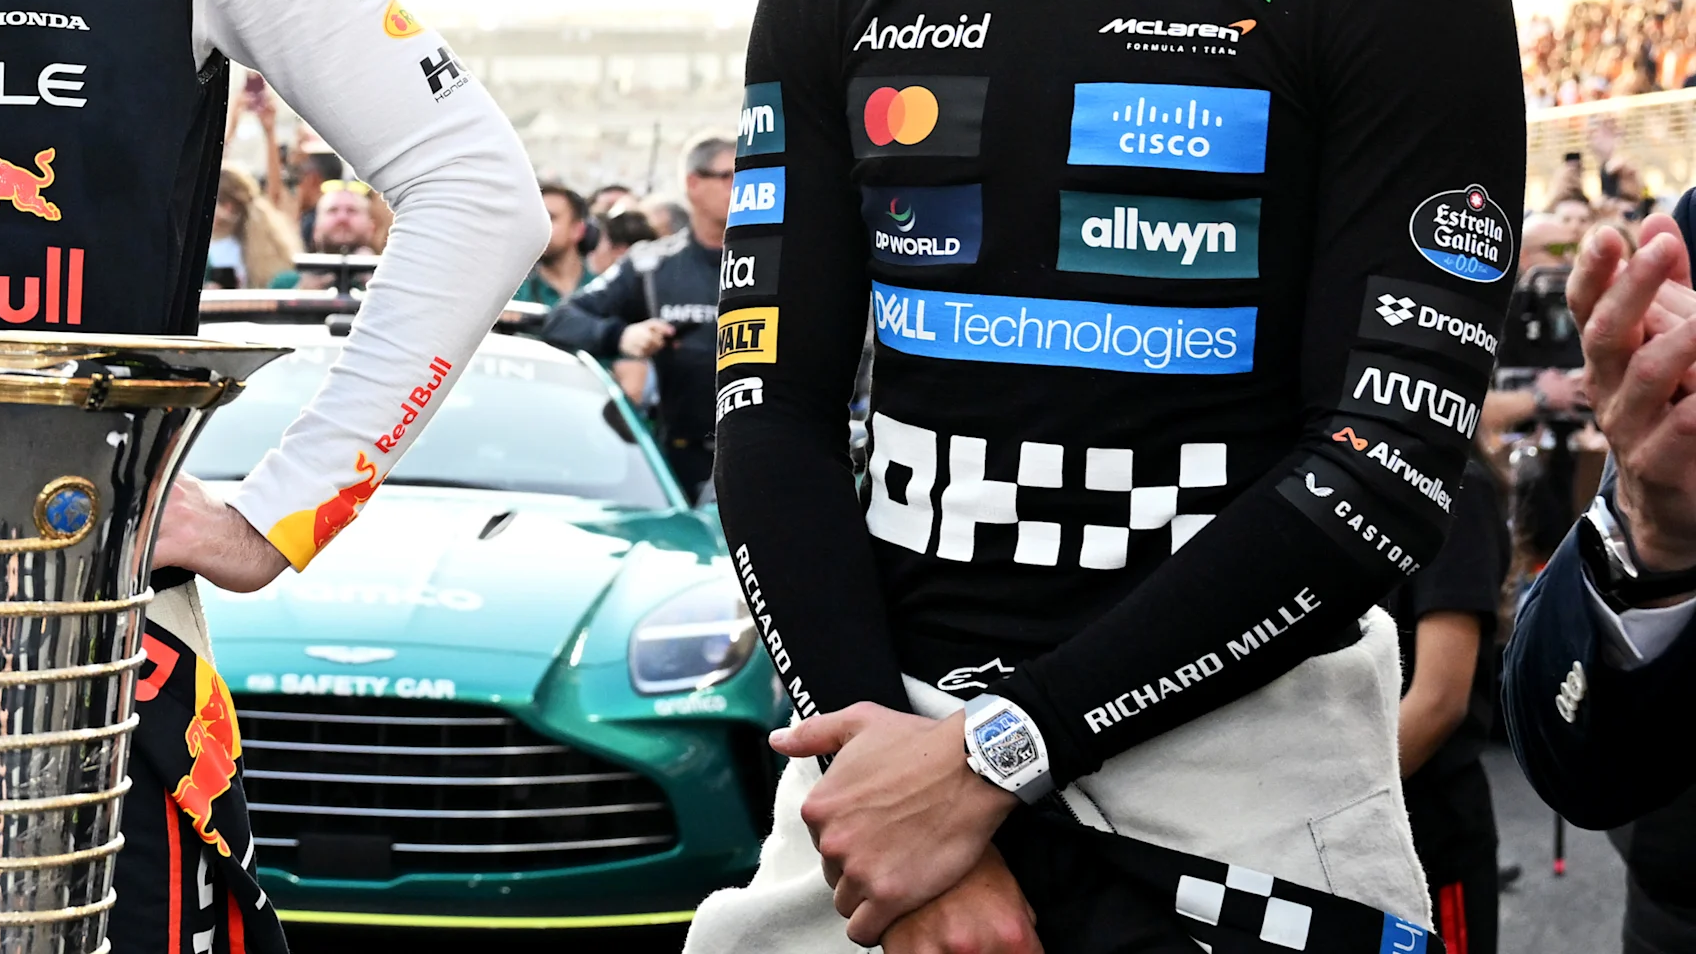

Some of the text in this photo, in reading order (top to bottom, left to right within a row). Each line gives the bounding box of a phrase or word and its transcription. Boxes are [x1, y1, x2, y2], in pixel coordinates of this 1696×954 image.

[853, 13, 992, 52] Android
[1098, 18, 1240, 42] McLaren
[1126, 42, 1184, 52] FORMULA
[1204, 46, 1237, 56] TEAM
[875, 230, 961, 256] DP WORLD
[1080, 206, 1238, 264] allwyn
[1433, 203, 1503, 242] Estrella
[1434, 225, 1499, 263] Galicia
[874, 290, 1238, 369] DELL Technologies
[1418, 305, 1499, 357] Dropbox
[374, 356, 453, 454] Red Bull
[1367, 441, 1453, 514] Airwallex
[736, 544, 792, 674] RICHARD
[1084, 586, 1322, 734] RICHARD MILLE
[281, 673, 387, 698] SAFETY
[395, 675, 456, 699] CAR
